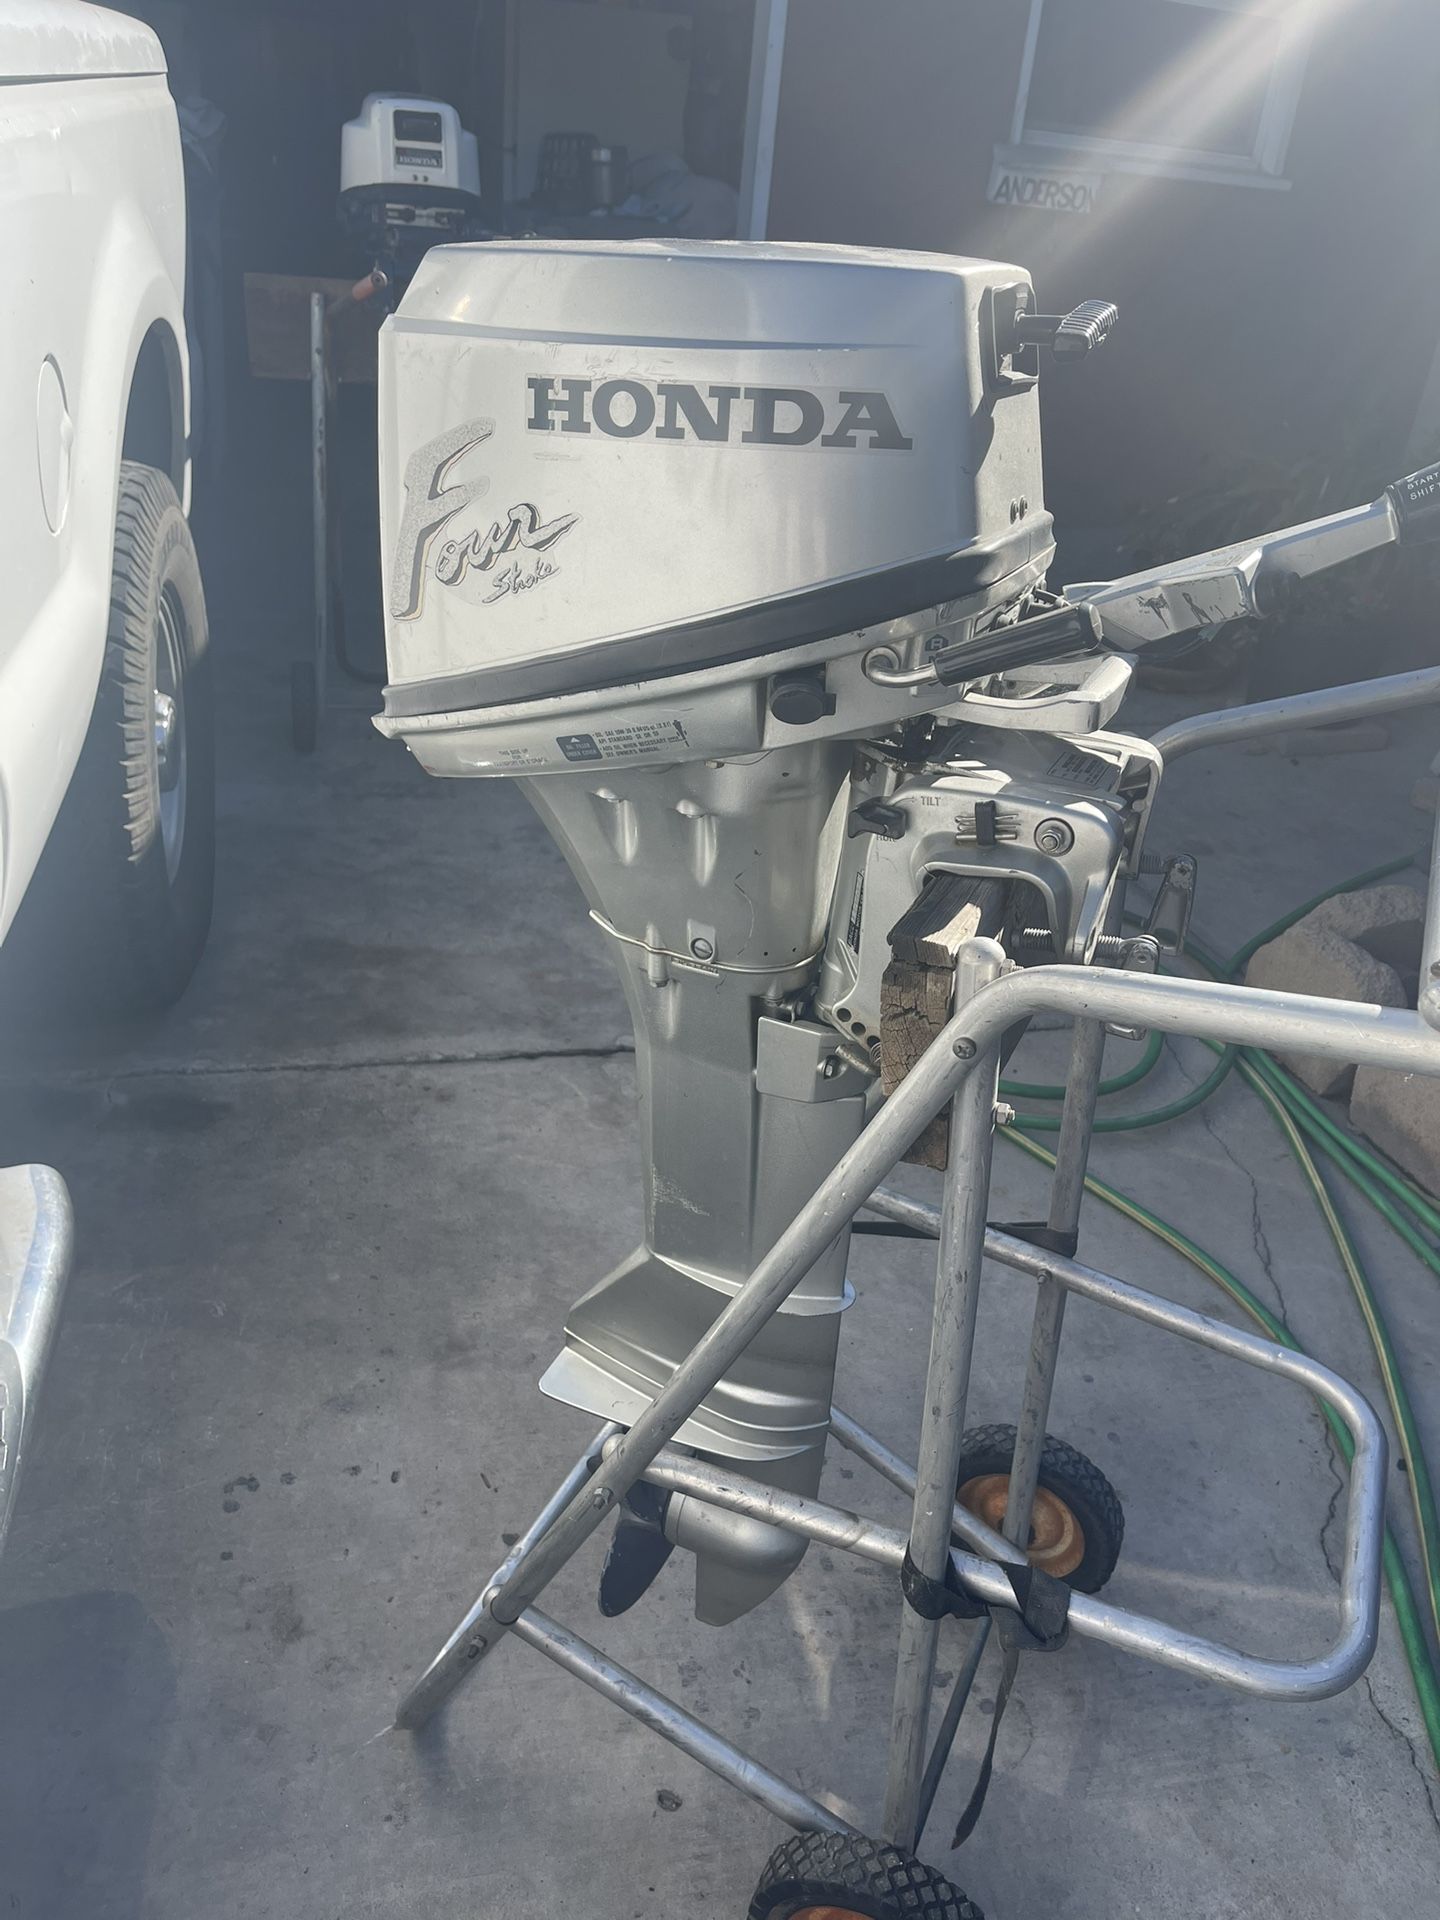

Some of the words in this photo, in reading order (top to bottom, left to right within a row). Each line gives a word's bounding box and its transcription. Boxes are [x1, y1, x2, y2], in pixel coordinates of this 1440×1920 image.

[527, 378, 913, 451] HONDA
[1407, 472, 1439, 490] START
[392, 417, 581, 621] Four
[482, 557, 560, 603] Stroke
[920, 795, 942, 807] TILT
